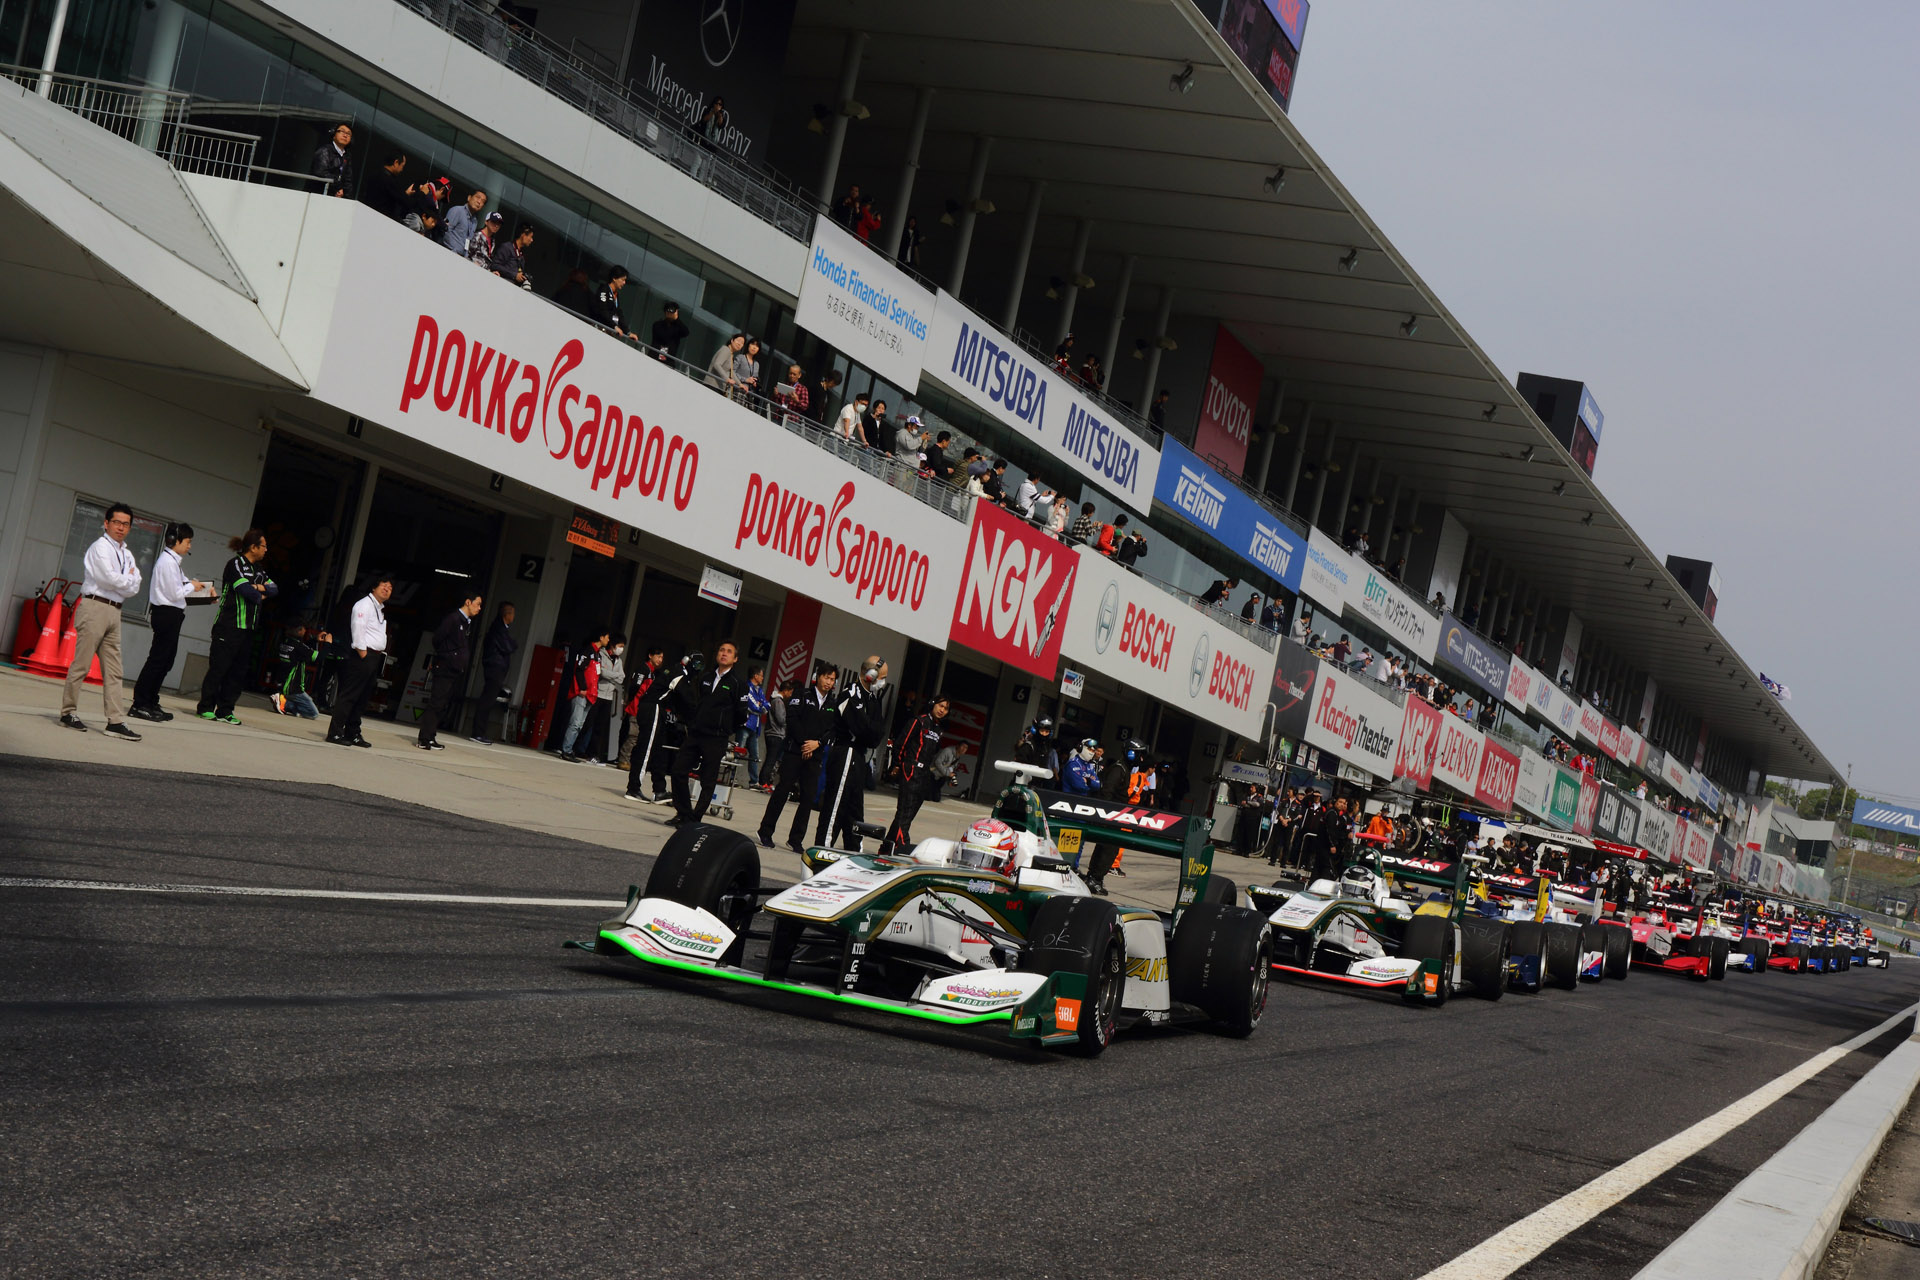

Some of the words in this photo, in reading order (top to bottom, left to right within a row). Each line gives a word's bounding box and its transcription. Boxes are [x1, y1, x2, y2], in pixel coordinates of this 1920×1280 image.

[813, 246, 847, 288] Honda
[848, 269, 891, 316] Financial
[889, 298, 927, 341] Services
[952, 323, 1047, 431] MITSUBA
[1208, 374, 1254, 447] TOYOTA
[1062, 403, 1140, 495] MITSUBA
[1173, 475, 1224, 530] KEIHIN
[523, 559, 537, 578] 2
[1248, 529, 1292, 578] KEIHIN
[959, 519, 1054, 657] NGK
[754, 641, 765, 659] 4
[1119, 601, 1175, 673] BOSCH
[1016, 688, 1026, 700] 6
[1208, 650, 1255, 712] BOSCH
[1441, 726, 1479, 783] DENSO
[1481, 751, 1515, 801] DENSO
[1047, 800, 1166, 829] ADVAN
[801, 880, 872, 893] 37
[1366, 853, 1441, 872] ADVAN
[890, 921, 908, 937] JTEKT
[1059, 1006, 1075, 1022] JBL
